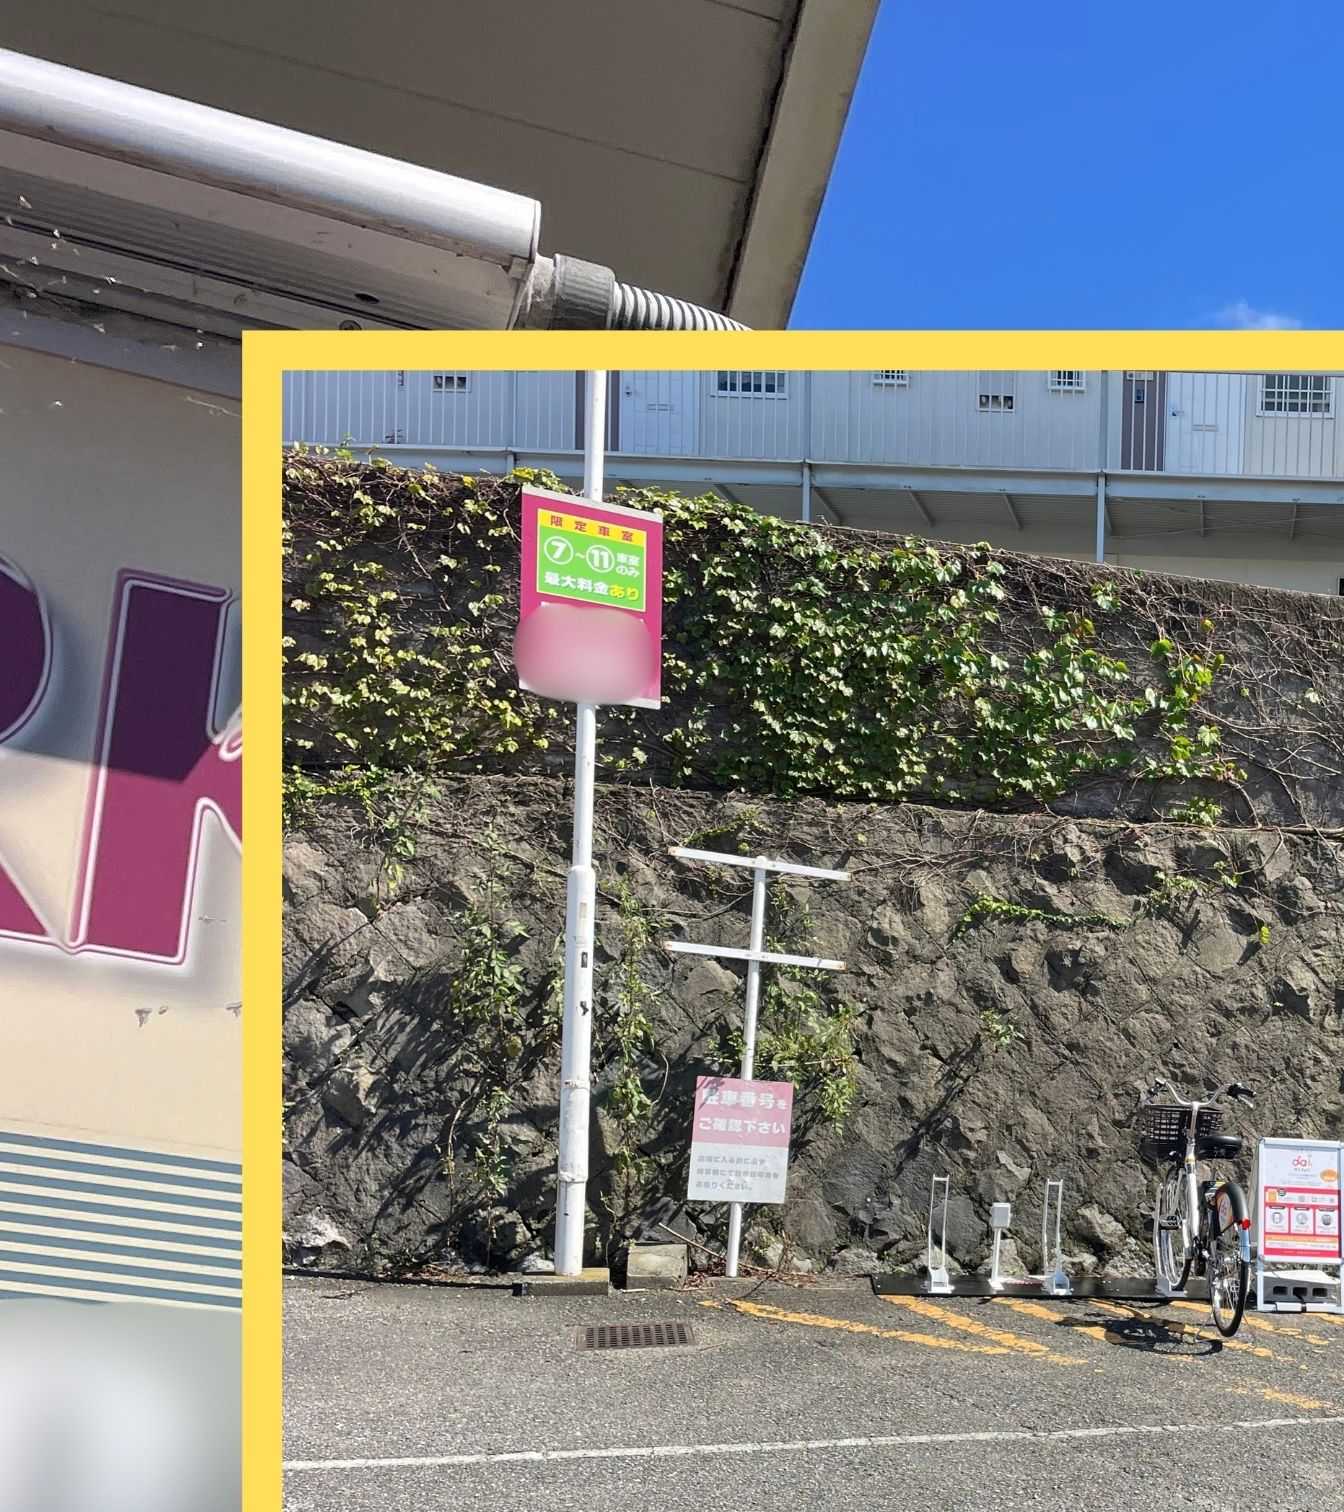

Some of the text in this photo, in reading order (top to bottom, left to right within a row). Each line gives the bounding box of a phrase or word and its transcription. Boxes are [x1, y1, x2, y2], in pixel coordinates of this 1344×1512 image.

[543, 571, 641, 601] 最大料金あり
